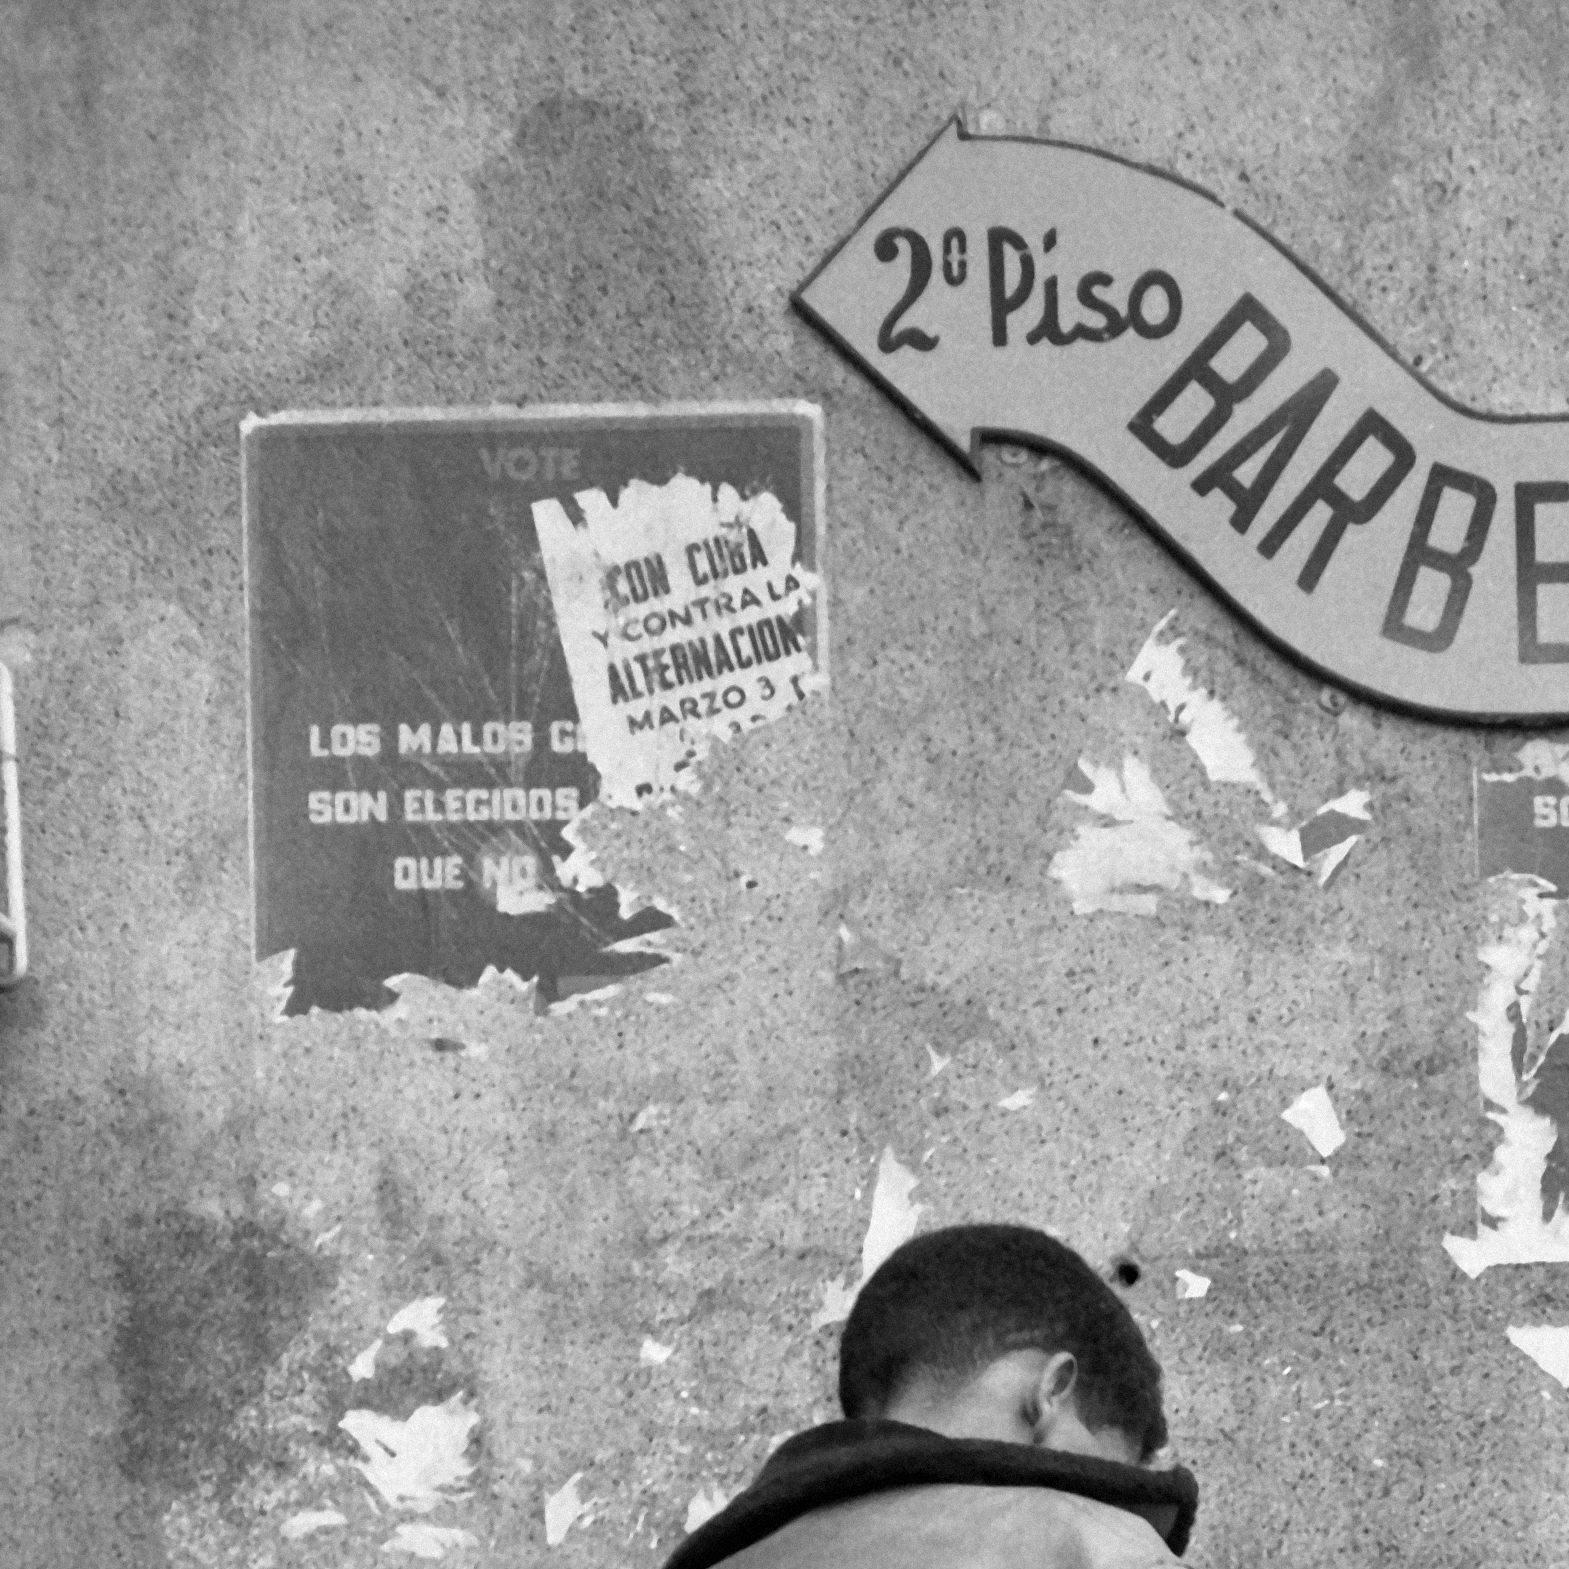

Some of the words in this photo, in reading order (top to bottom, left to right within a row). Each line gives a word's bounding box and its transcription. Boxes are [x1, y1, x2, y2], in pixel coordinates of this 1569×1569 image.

[988, 226, 1184, 348] Piso
[479, 447, 583, 482] VOTE
[622, 587, 763, 643] CONTRA
[766, 573, 801, 601] LA
[626, 690, 723, 736] MARZO
[308, 723, 382, 757] LOS
[397, 720, 534, 756] MALOS
[307, 789, 391, 825] SON
[401, 786, 582, 822] ELEGIDOS
[392, 855, 466, 891] QUE
